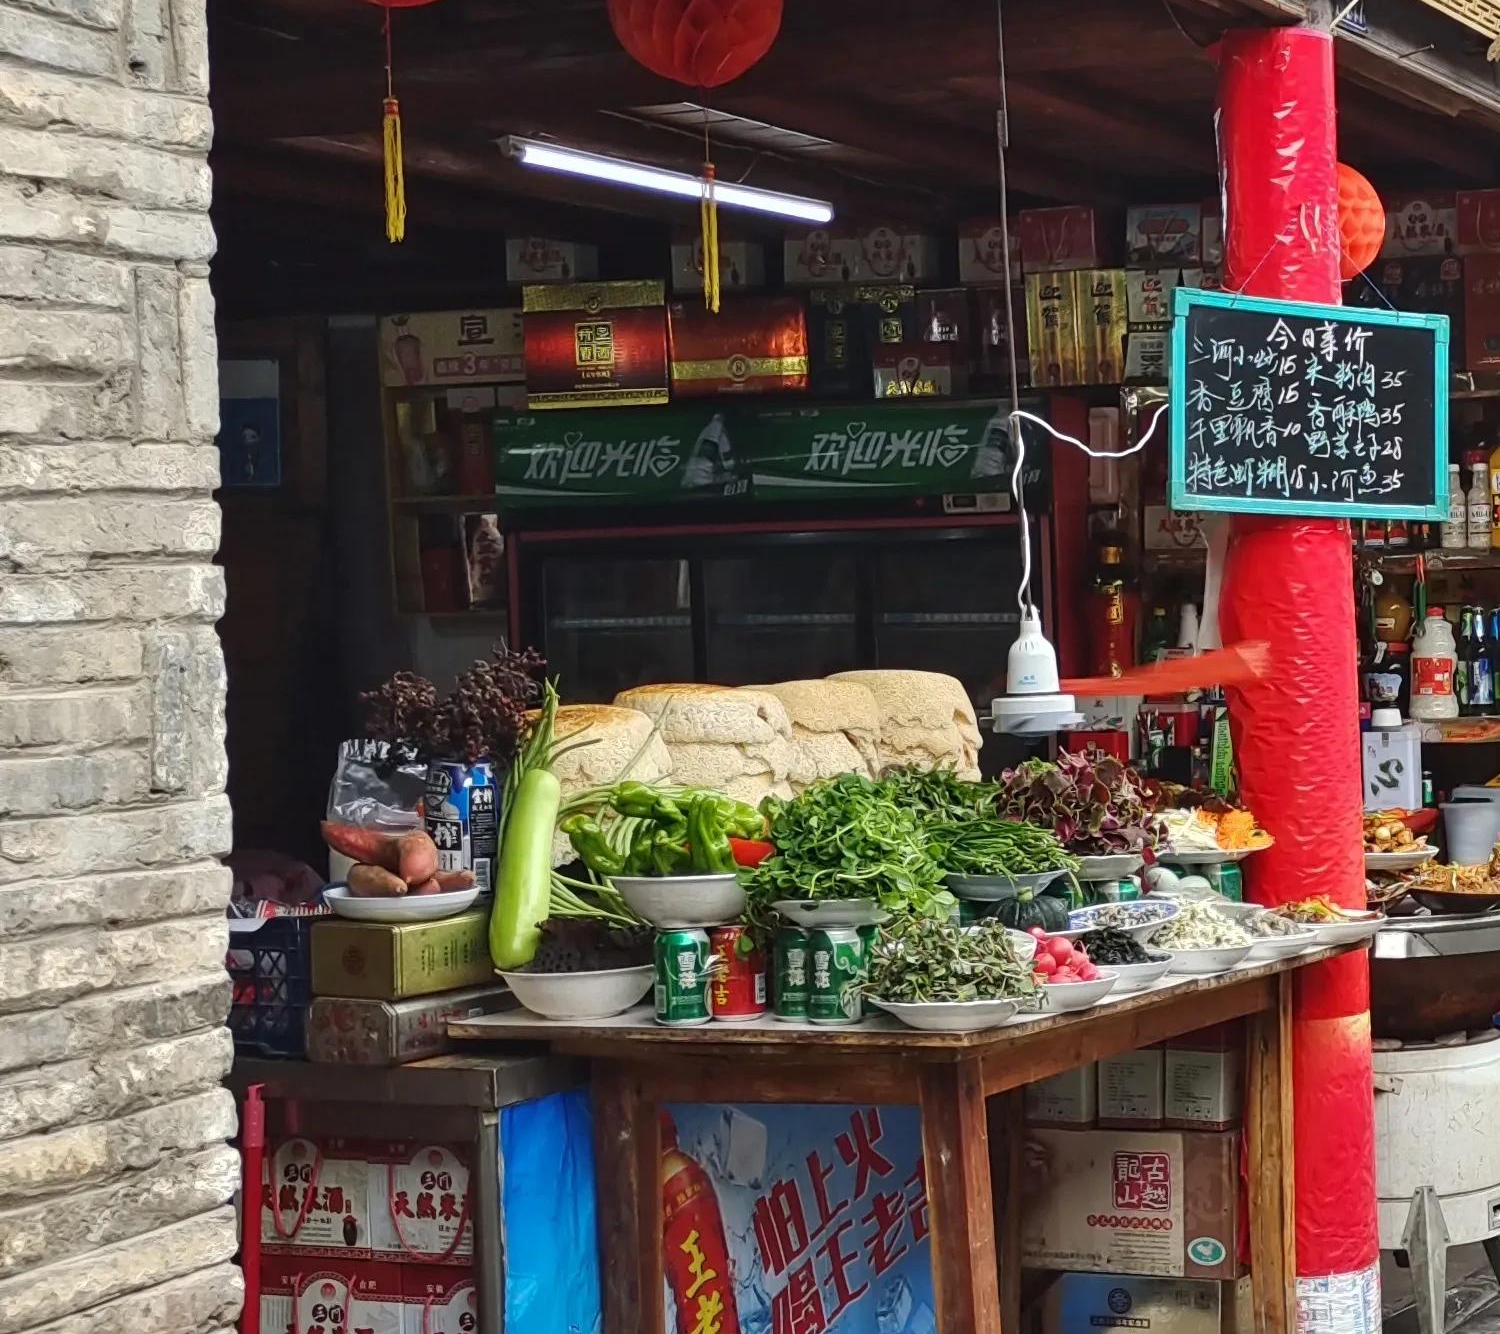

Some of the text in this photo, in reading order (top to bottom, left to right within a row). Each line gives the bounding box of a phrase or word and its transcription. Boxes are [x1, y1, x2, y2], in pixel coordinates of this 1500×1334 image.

[1266, 317, 1373, 370] 今日菜价
[523, 431, 681, 485] 欢迎光临
[804, 421, 969, 478] 欢迎光临
[753, 1107, 897, 1279] 怕上火
